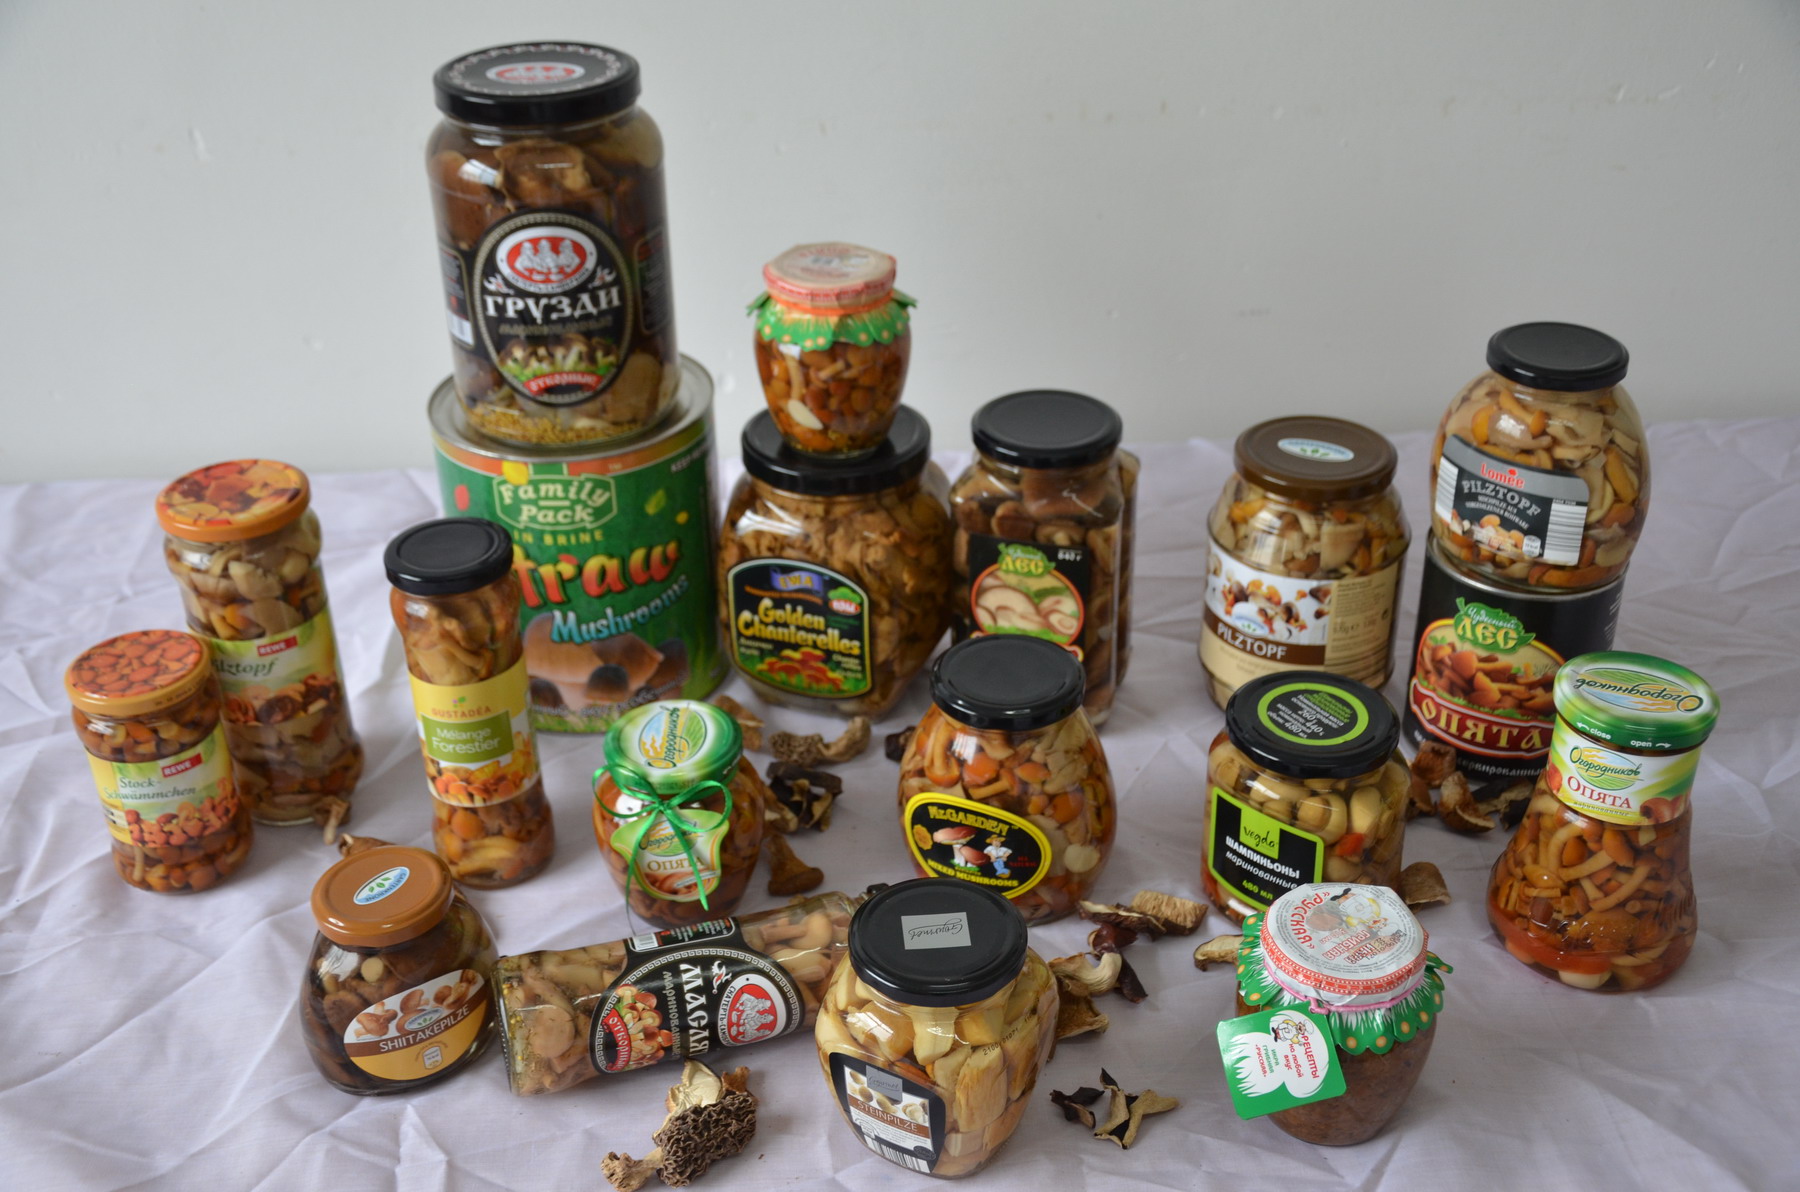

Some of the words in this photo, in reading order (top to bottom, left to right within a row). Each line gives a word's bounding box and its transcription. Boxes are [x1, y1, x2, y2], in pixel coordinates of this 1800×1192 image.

[483, 286, 622, 325] ГРУЗДИ
[498, 479, 611, 507] Family
[1462, 480, 1541, 516] PILZTOPF
[518, 500, 595, 524] Pack
[513, 530, 534, 544] IN
[542, 529, 605, 546] BRINE
[512, 540, 681, 608] traw
[551, 573, 690, 645] Mushrooms
[757, 597, 827, 632] Golden
[737, 610, 862, 656] Chanterelles
[1217, 622, 1287, 660] PILZTOPF
[1573, 678, 1704, 712] Огородников
[436, 727, 492, 745] Mélange
[1420, 696, 1544, 750] ОПЯТА
[1589, 726, 1612, 740] close
[431, 736, 500, 755] Forestier
[1630, 740, 1653, 749] open
[163, 759, 193, 776] REWE
[1569, 745, 1643, 778] Огородников
[103, 786, 197, 801] Schwämmchen
[119, 776, 162, 790] Stock-
[1567, 775, 1632, 809] ОПЯТА
[1225, 835, 1300, 879] ШАМПИНЬОНЫ
[1225, 851, 1299, 890] маринованные
[927, 858, 956, 877] MIXED
[955, 871, 1019, 888] MUSHROOMS
[1242, 880, 1259, 893] 480
[1260, 890, 1274, 900] мл
[907, 916, 964, 941] Gourmet
[1322, 929, 1371, 960] ГРИБНАЯ
[379, 1003, 471, 1053] SHIITAKEPILZE
[1262, 1044, 1275, 1074] ГРИБНАЯ
[1271, 1049, 1280, 1066] ИКРА
[1283, 1054, 1293, 1071] вкус
[1291, 1054, 1305, 1078] любой
[1301, 1035, 1320, 1079] РЕЦЕПТЫ
[868, 1075, 901, 1092] Gourmet
[857, 1100, 918, 1132] STEINPILZE
